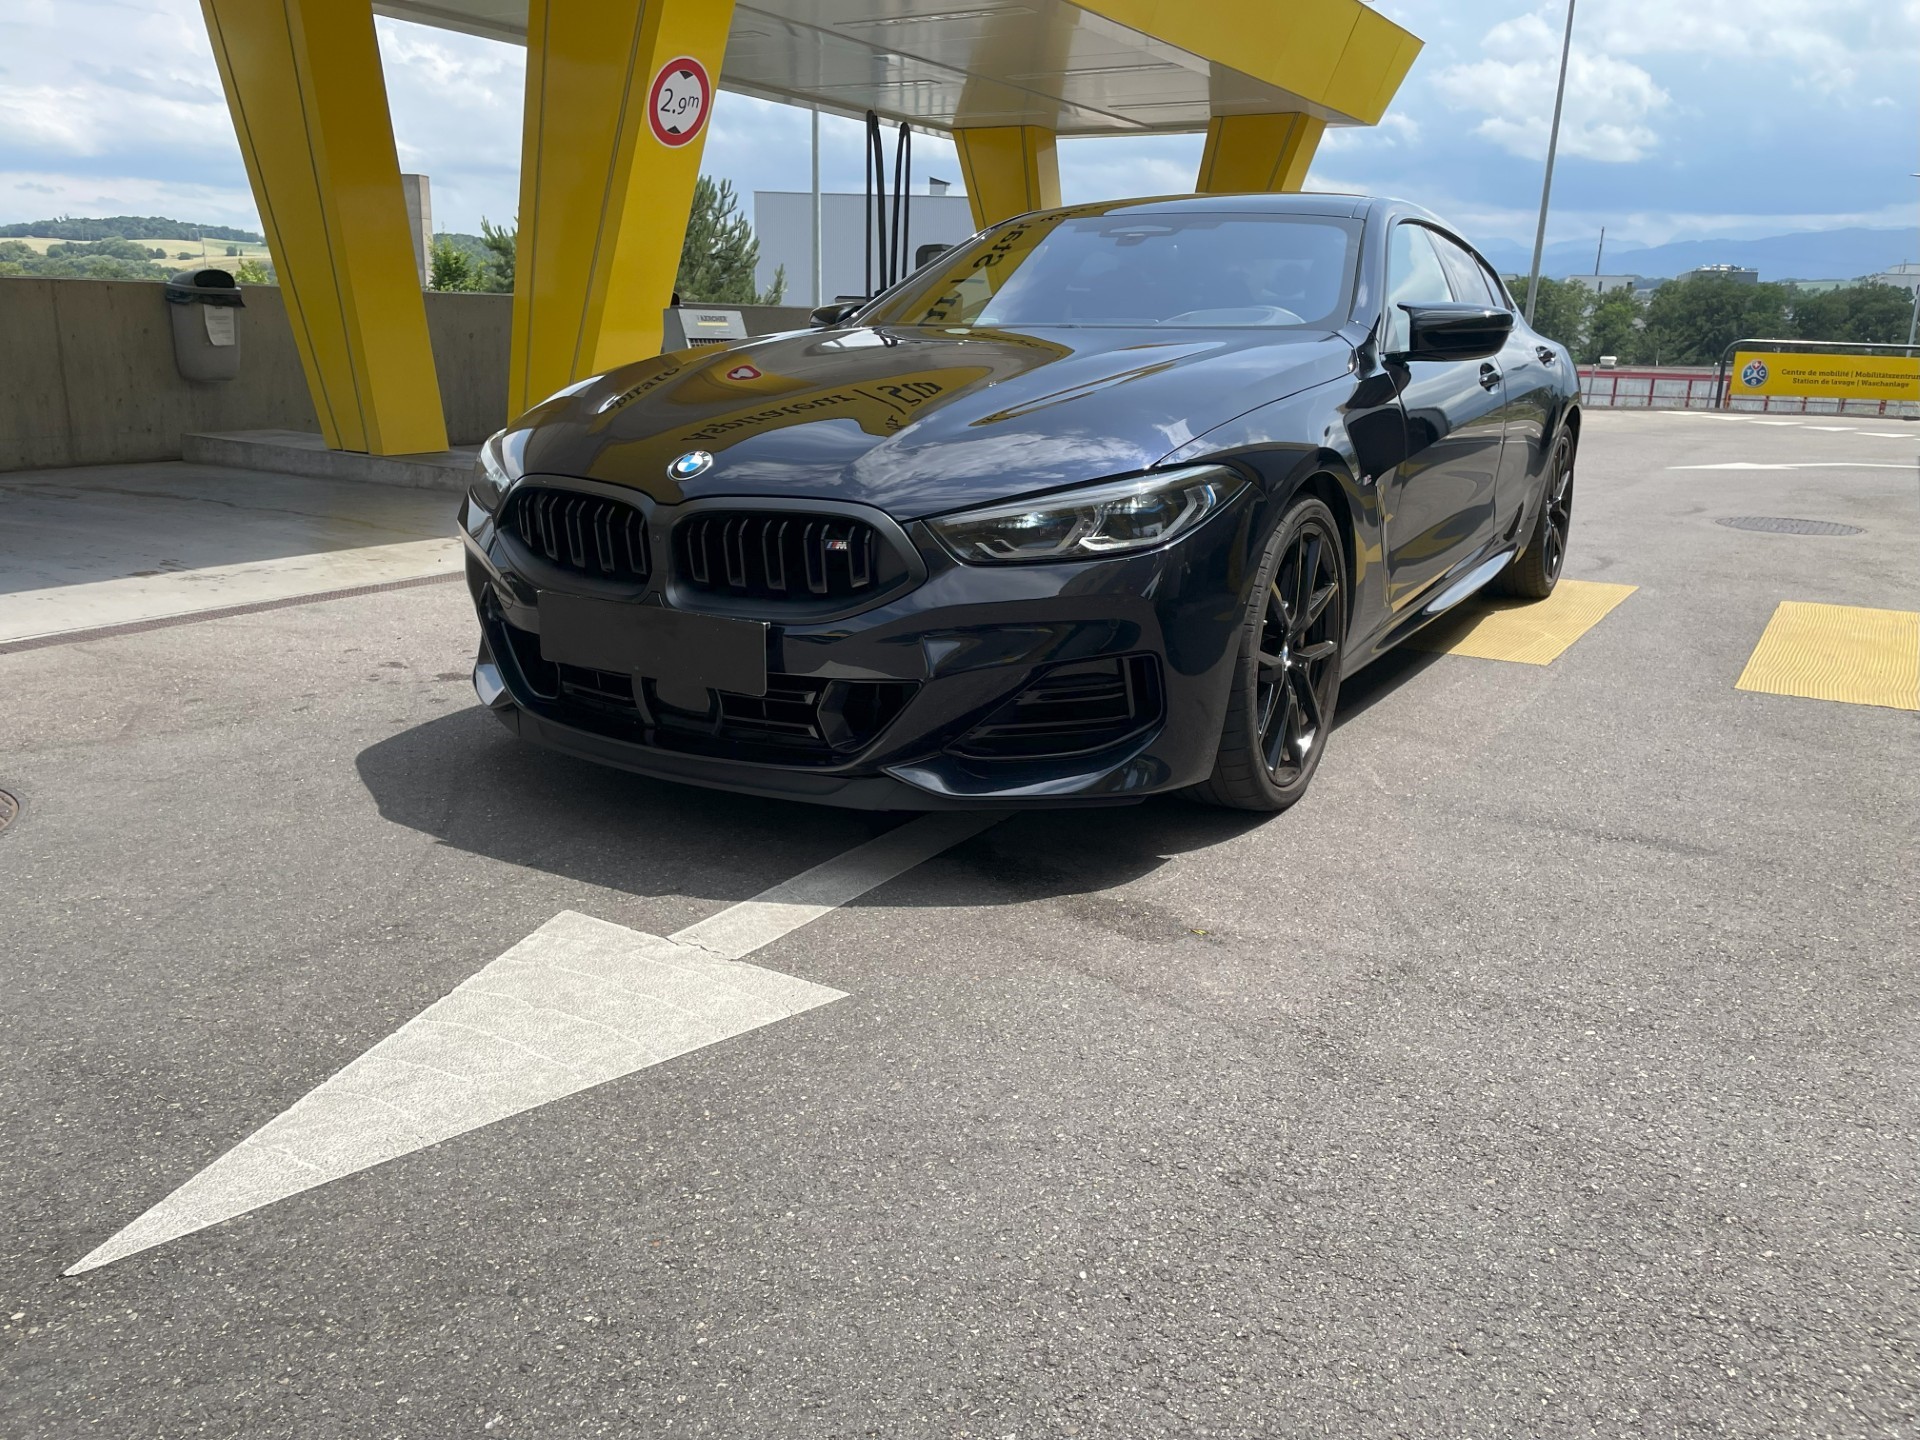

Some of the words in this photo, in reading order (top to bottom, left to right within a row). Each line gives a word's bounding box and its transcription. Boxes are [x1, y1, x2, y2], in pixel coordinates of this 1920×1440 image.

[1792, 377, 1819, 385] Station
[1832, 379, 1855, 387] lavage
[1861, 380, 1910, 389] Waschanlage
